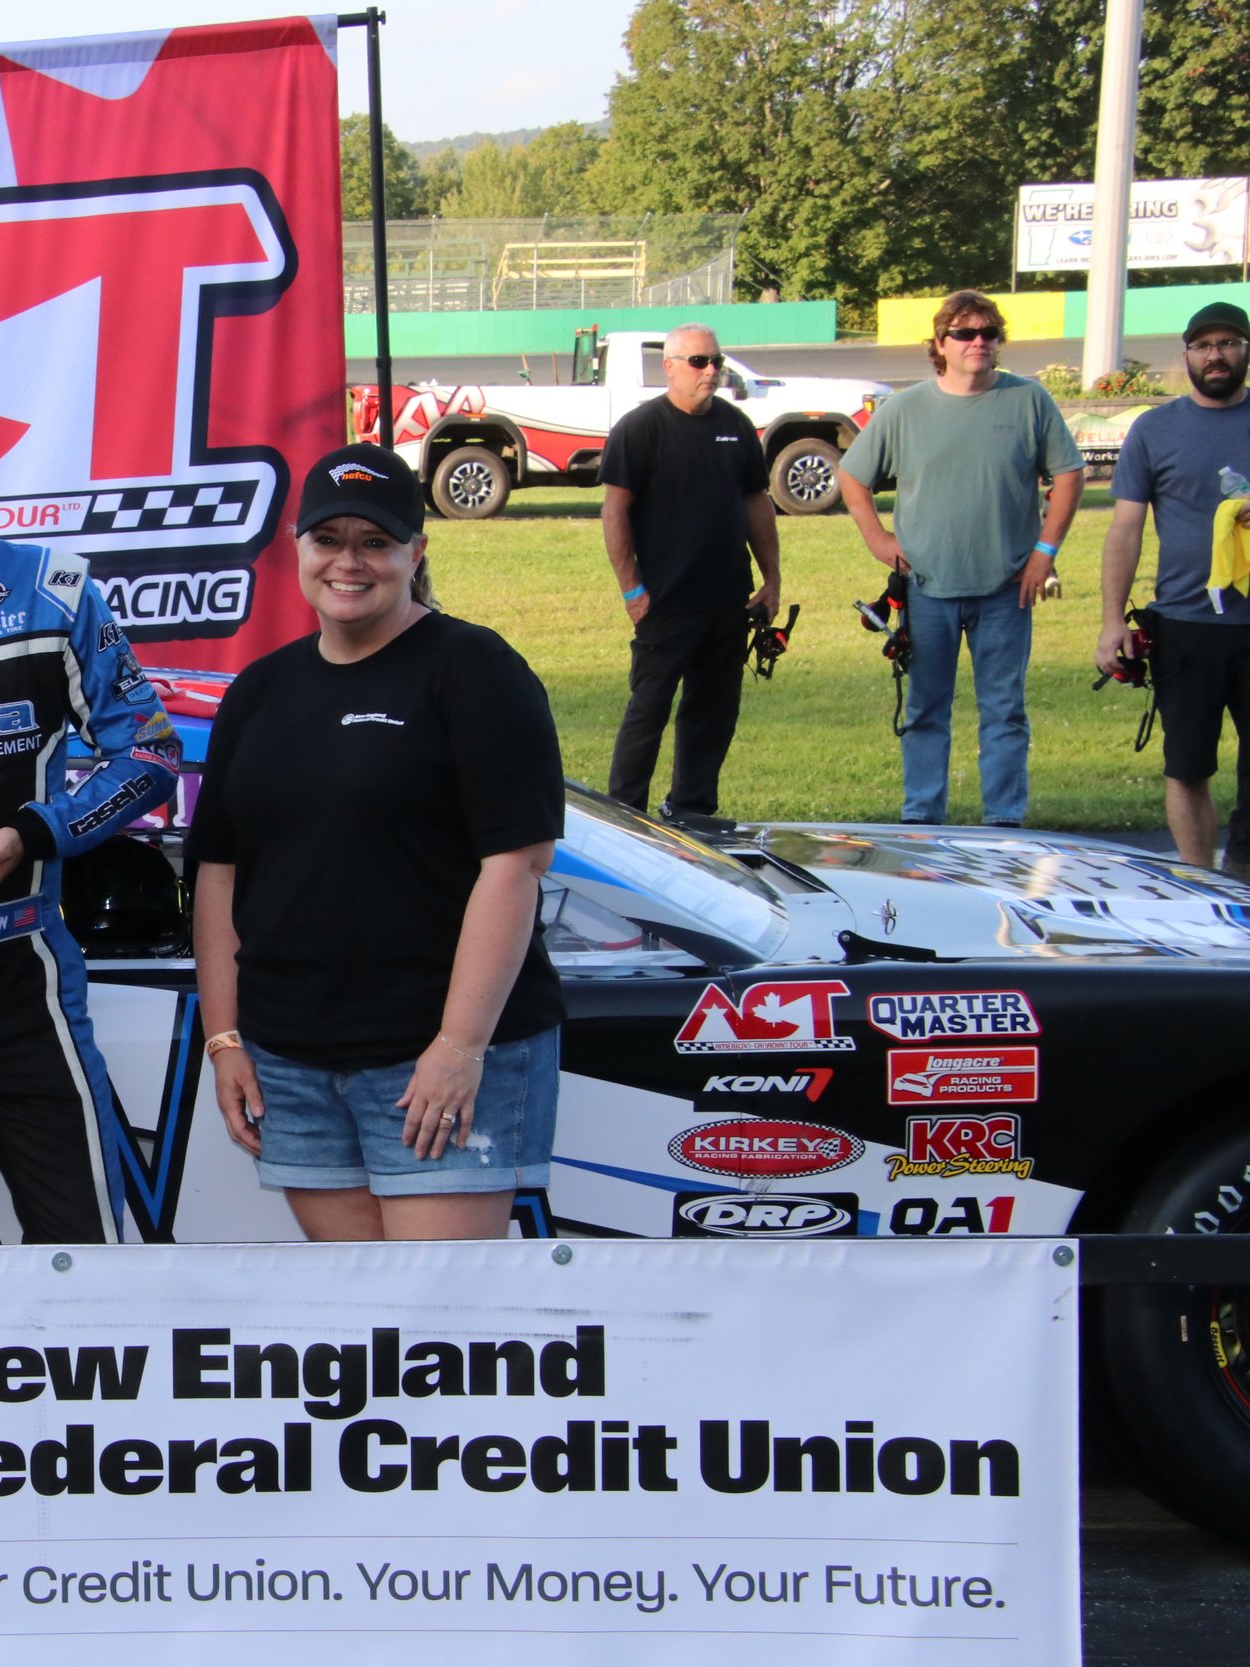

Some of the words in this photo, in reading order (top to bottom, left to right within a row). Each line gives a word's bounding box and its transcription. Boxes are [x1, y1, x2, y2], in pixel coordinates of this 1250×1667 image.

[1023, 204, 1093, 222] WE'RE
[1129, 200, 1179, 218] RING
[342, 472, 372, 481] nefcu
[62, 502, 84, 512] LTD.
[48, 570, 82, 588] K1
[100, 576, 242, 619] ACING
[6, 625, 23, 633] TIRE
[68, 772, 154, 839] casella
[676, 979, 851, 1042] ACT
[872, 994, 1023, 1025] QUARTER
[901, 1013, 1032, 1038] MASTER
[789, 1041, 809, 1049] TOUR
[926, 1055, 1001, 1071] Longacre
[702, 1075, 812, 1092] KONI
[939, 1084, 1013, 1093] PRODUCTS
[950, 1076, 1002, 1085] RACING
[694, 1136, 823, 1152] KIRKEY
[909, 1117, 1016, 1163] KRC
[885, 1154, 947, 1182] Power
[941, 1152, 1032, 1180] Steering
[701, 1203, 832, 1227] DRP
[889, 1196, 1016, 1235] QA1
[172, 1325, 605, 1420] England
[338, 1418, 678, 1494] Credit
[699, 1420, 1020, 1497] Union
[21, 1560, 172, 1605] Credit
[186, 1558, 343, 1602] Union.
[356, 1562, 471, 1602] Your
[486, 1562, 678, 1613] Money.
[692, 1563, 808, 1603] Your
[825, 1564, 1007, 1610] Future.
